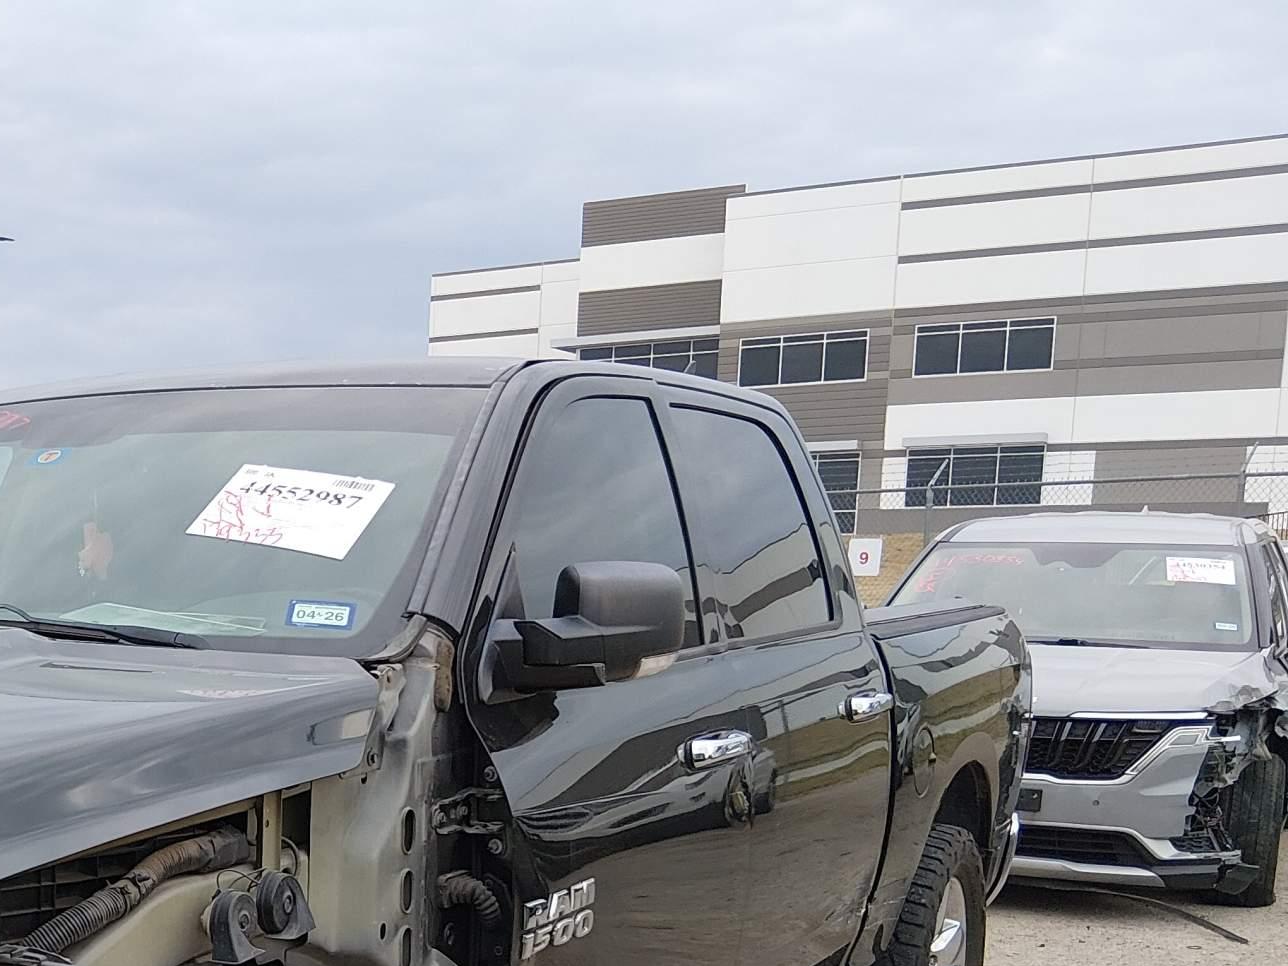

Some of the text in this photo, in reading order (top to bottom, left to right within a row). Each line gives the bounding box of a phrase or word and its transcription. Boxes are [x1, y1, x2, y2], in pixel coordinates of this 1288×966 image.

[240, 481, 363, 509] 44552987
[858, 551, 870, 565] 9
[523, 877, 595, 931] RAM
[520, 909, 595, 960] 1500
